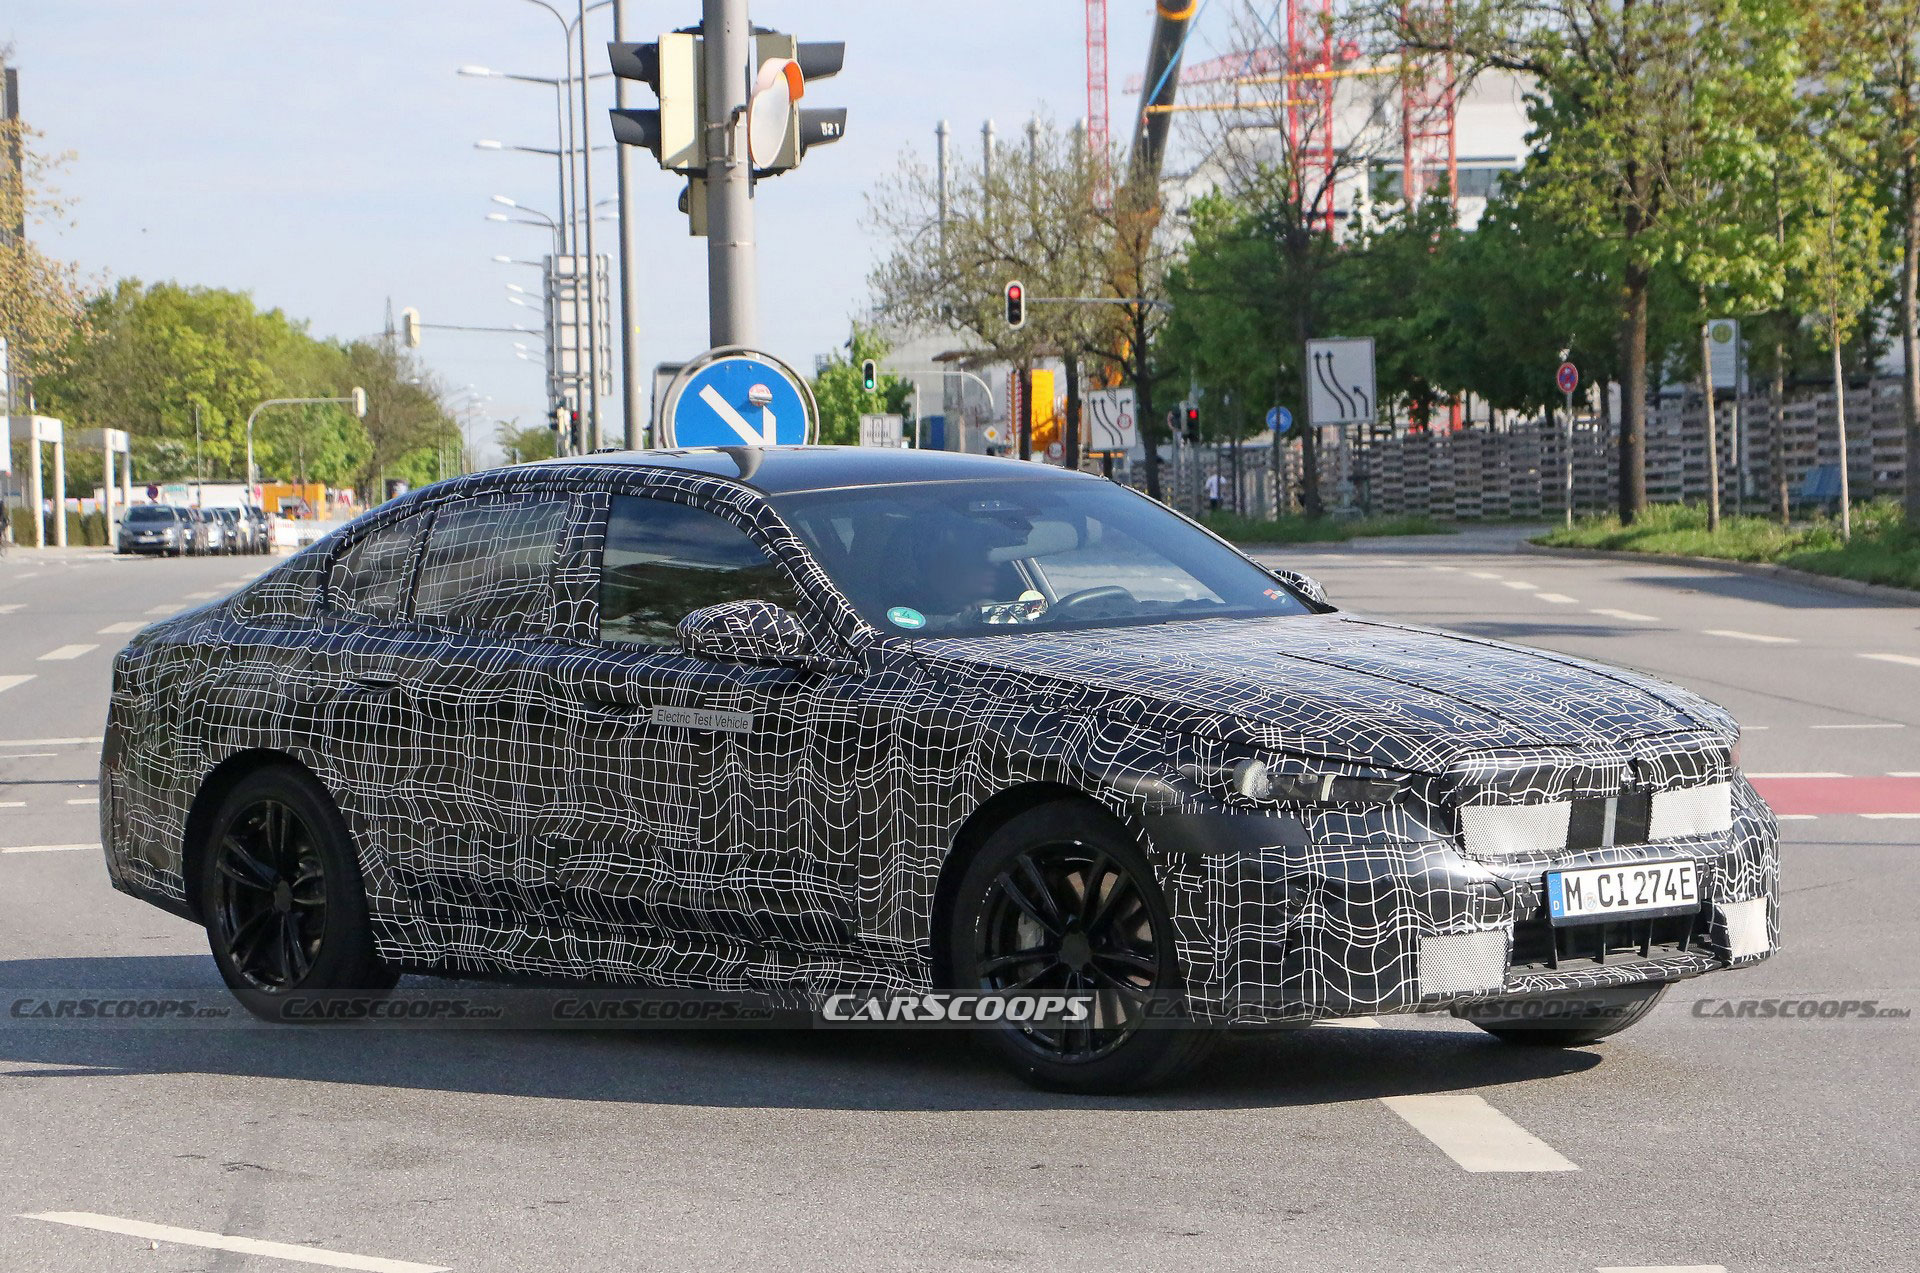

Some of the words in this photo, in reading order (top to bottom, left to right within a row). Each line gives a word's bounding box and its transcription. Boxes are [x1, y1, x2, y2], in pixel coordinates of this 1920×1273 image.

[656, 709, 691, 725] Electric
[693, 712, 713, 726] Test
[714, 714, 749, 730] Vehicle
[1564, 876, 1583, 911] M
[1553, 900, 1560, 911] D
